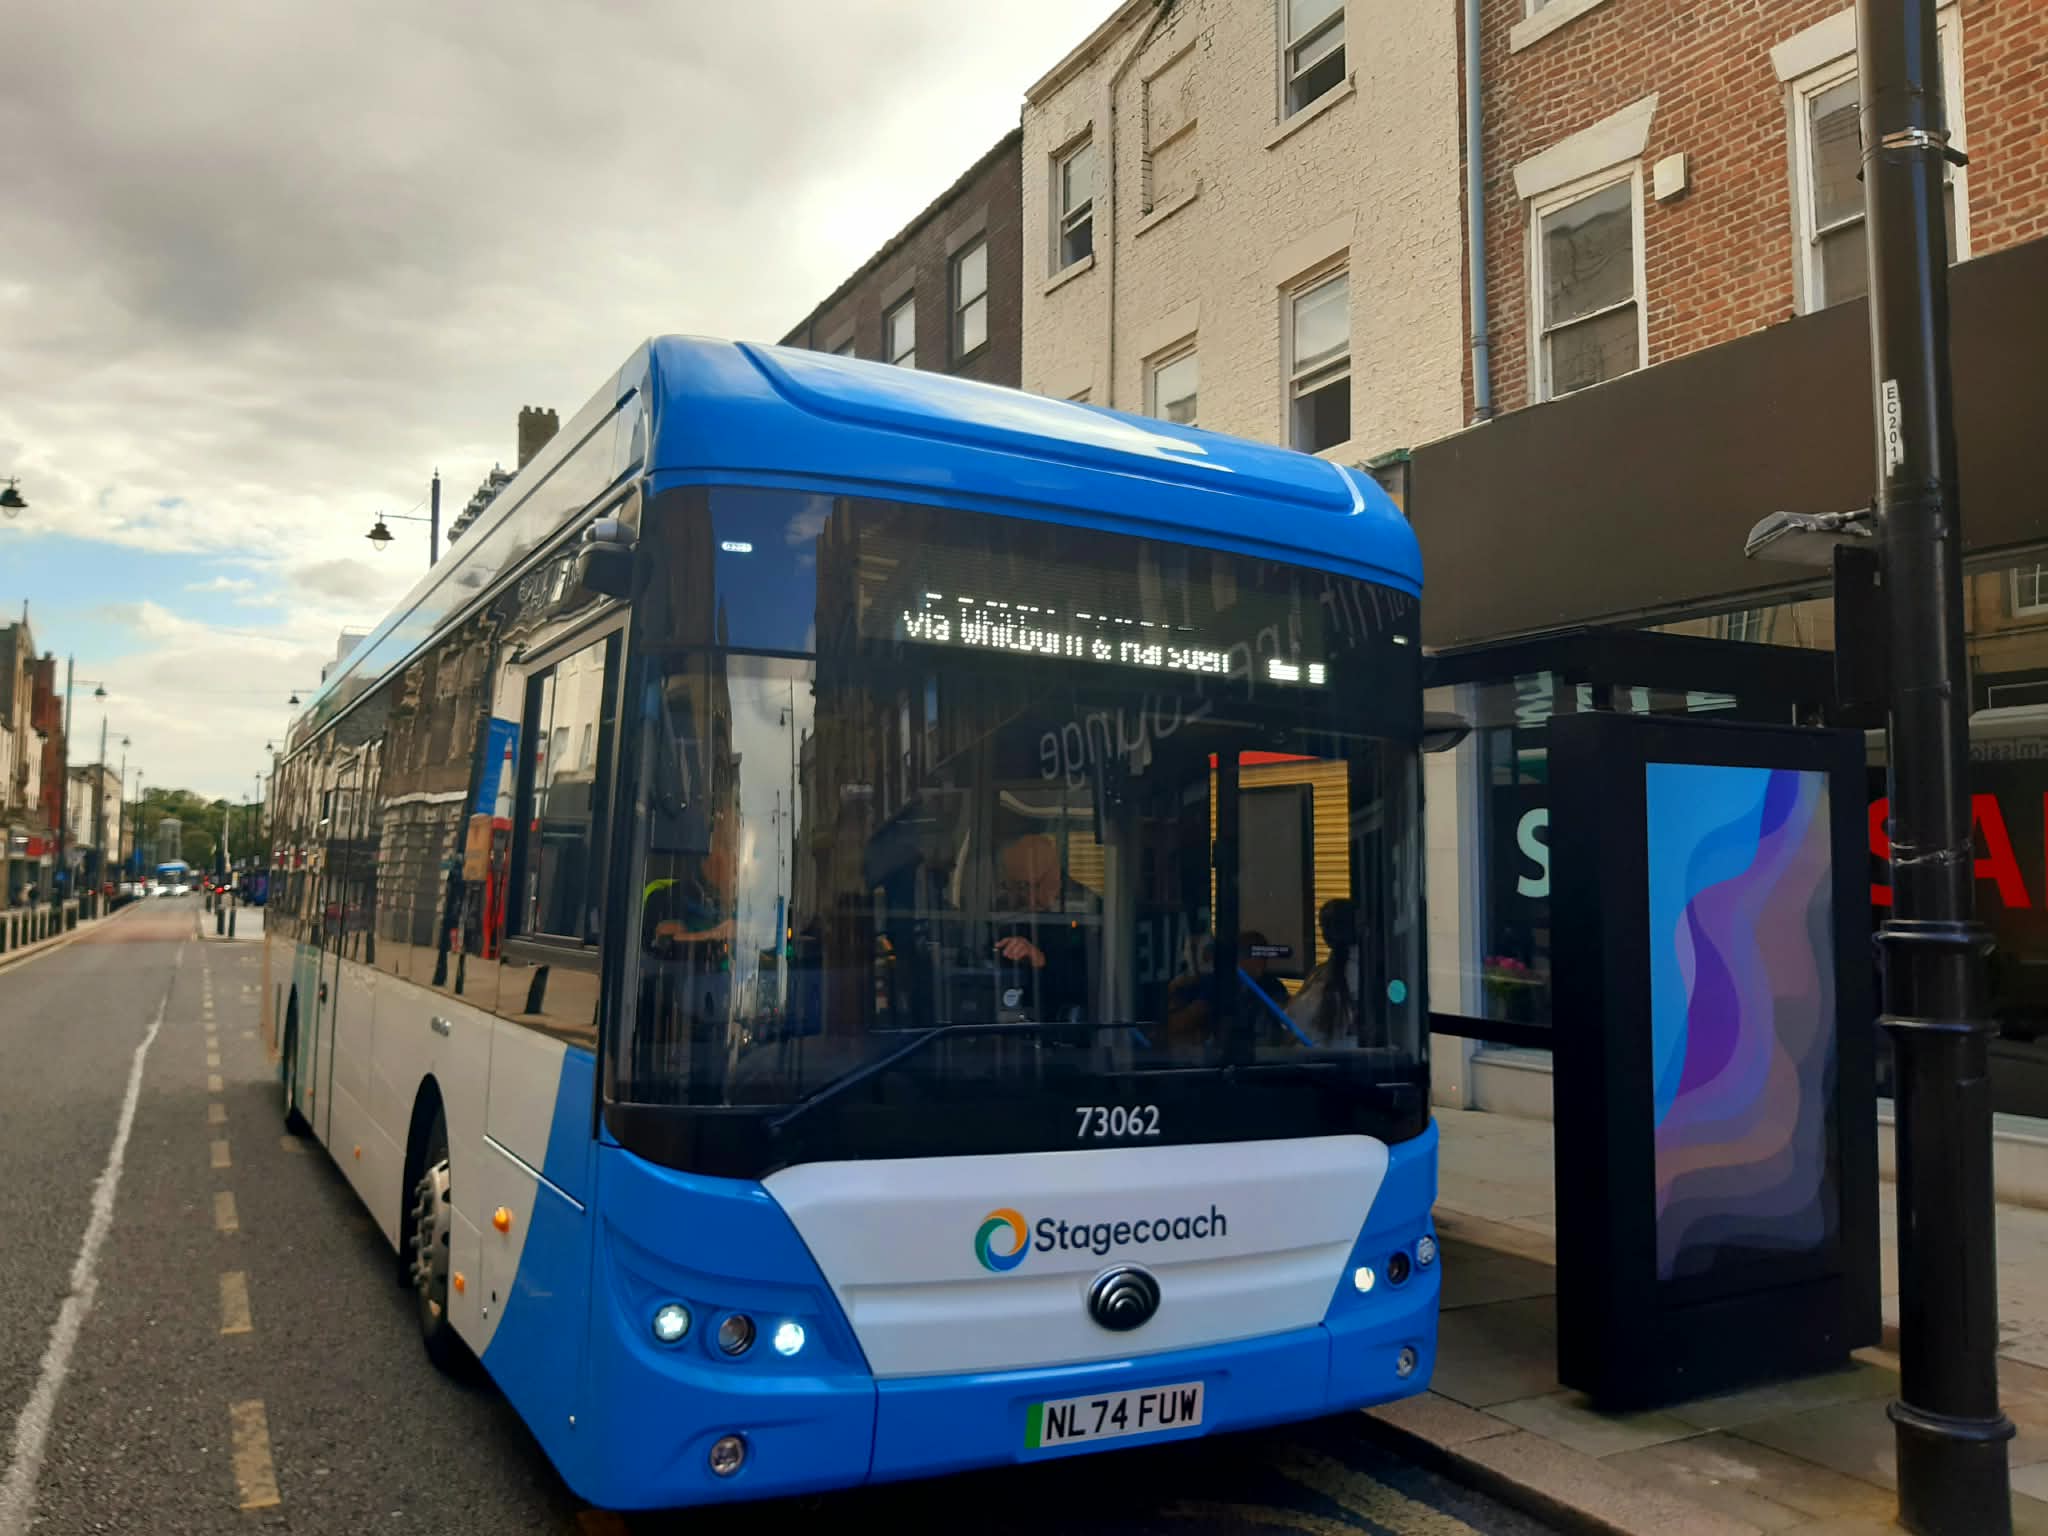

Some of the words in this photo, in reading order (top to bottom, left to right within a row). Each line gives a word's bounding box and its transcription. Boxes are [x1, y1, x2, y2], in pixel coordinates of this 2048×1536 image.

[1887, 386, 1898, 465] EC201
[903, 603, 950, 641] via
[1076, 1104, 1161, 1137] 73062
[1034, 1204, 1227, 1256] Stagecoach
[1138, 1389, 1198, 1427] FUW
